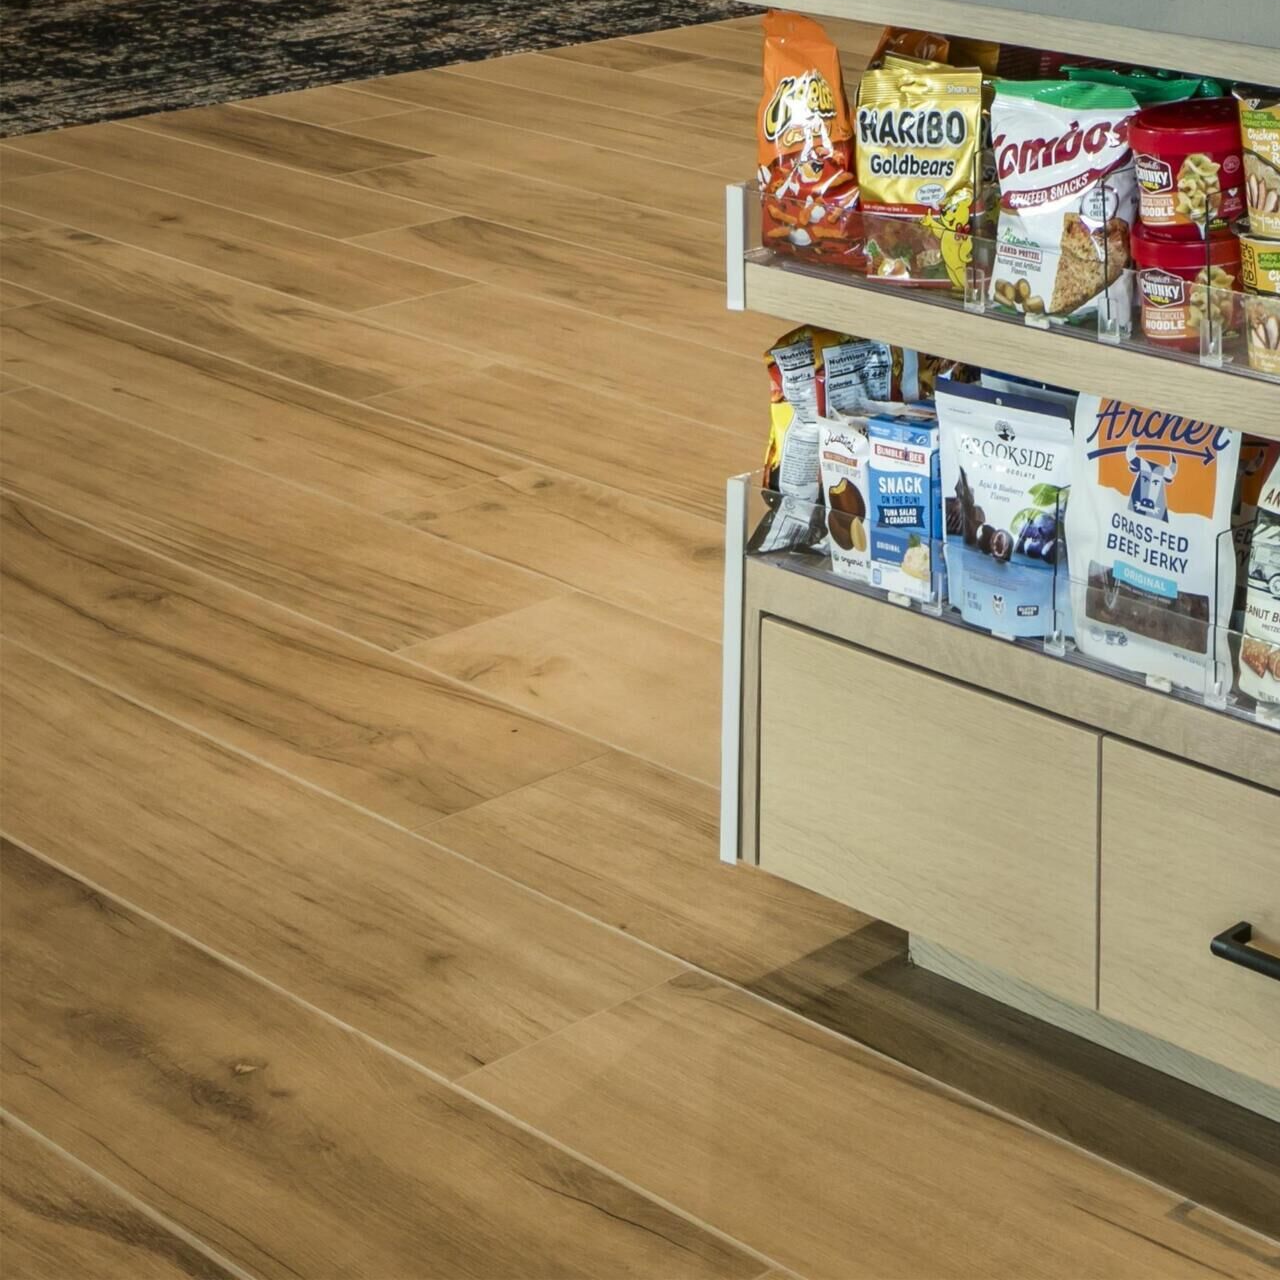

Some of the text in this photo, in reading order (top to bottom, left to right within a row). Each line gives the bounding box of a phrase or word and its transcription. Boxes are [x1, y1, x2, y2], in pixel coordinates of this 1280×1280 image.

[859, 110, 966, 145] HARIBO
[1248, 127, 1279, 140] Chicken
[993, 120, 1130, 180] ombos
[870, 153, 955, 177] Goldbears
[1050, 173, 1089, 200] SNACKS
[1141, 206, 1175, 218] NOODLE
[1018, 247, 1041, 261] PRETZEL
[1142, 278, 1180, 299] CHUNKY
[1145, 320, 1186, 330] NOODLE
[1087, 400, 1232, 451] Archer
[876, 444, 925, 464] BUMBLE BEE
[961, 437, 1055, 472] ROOKSIDE
[878, 476, 923, 495] SNACK
[881, 495, 891, 505] ON
[892, 495, 903, 506] THE
[883, 506, 918, 517] TUNA SALAD
[889, 515, 918, 525] CRACKERS
[1111, 512, 1190, 554] GRASS-FED
[840, 555, 864, 568] organic
[1106, 533, 1189, 575] BEEF JERKY
[1123, 566, 1168, 593] ORIGINAL
